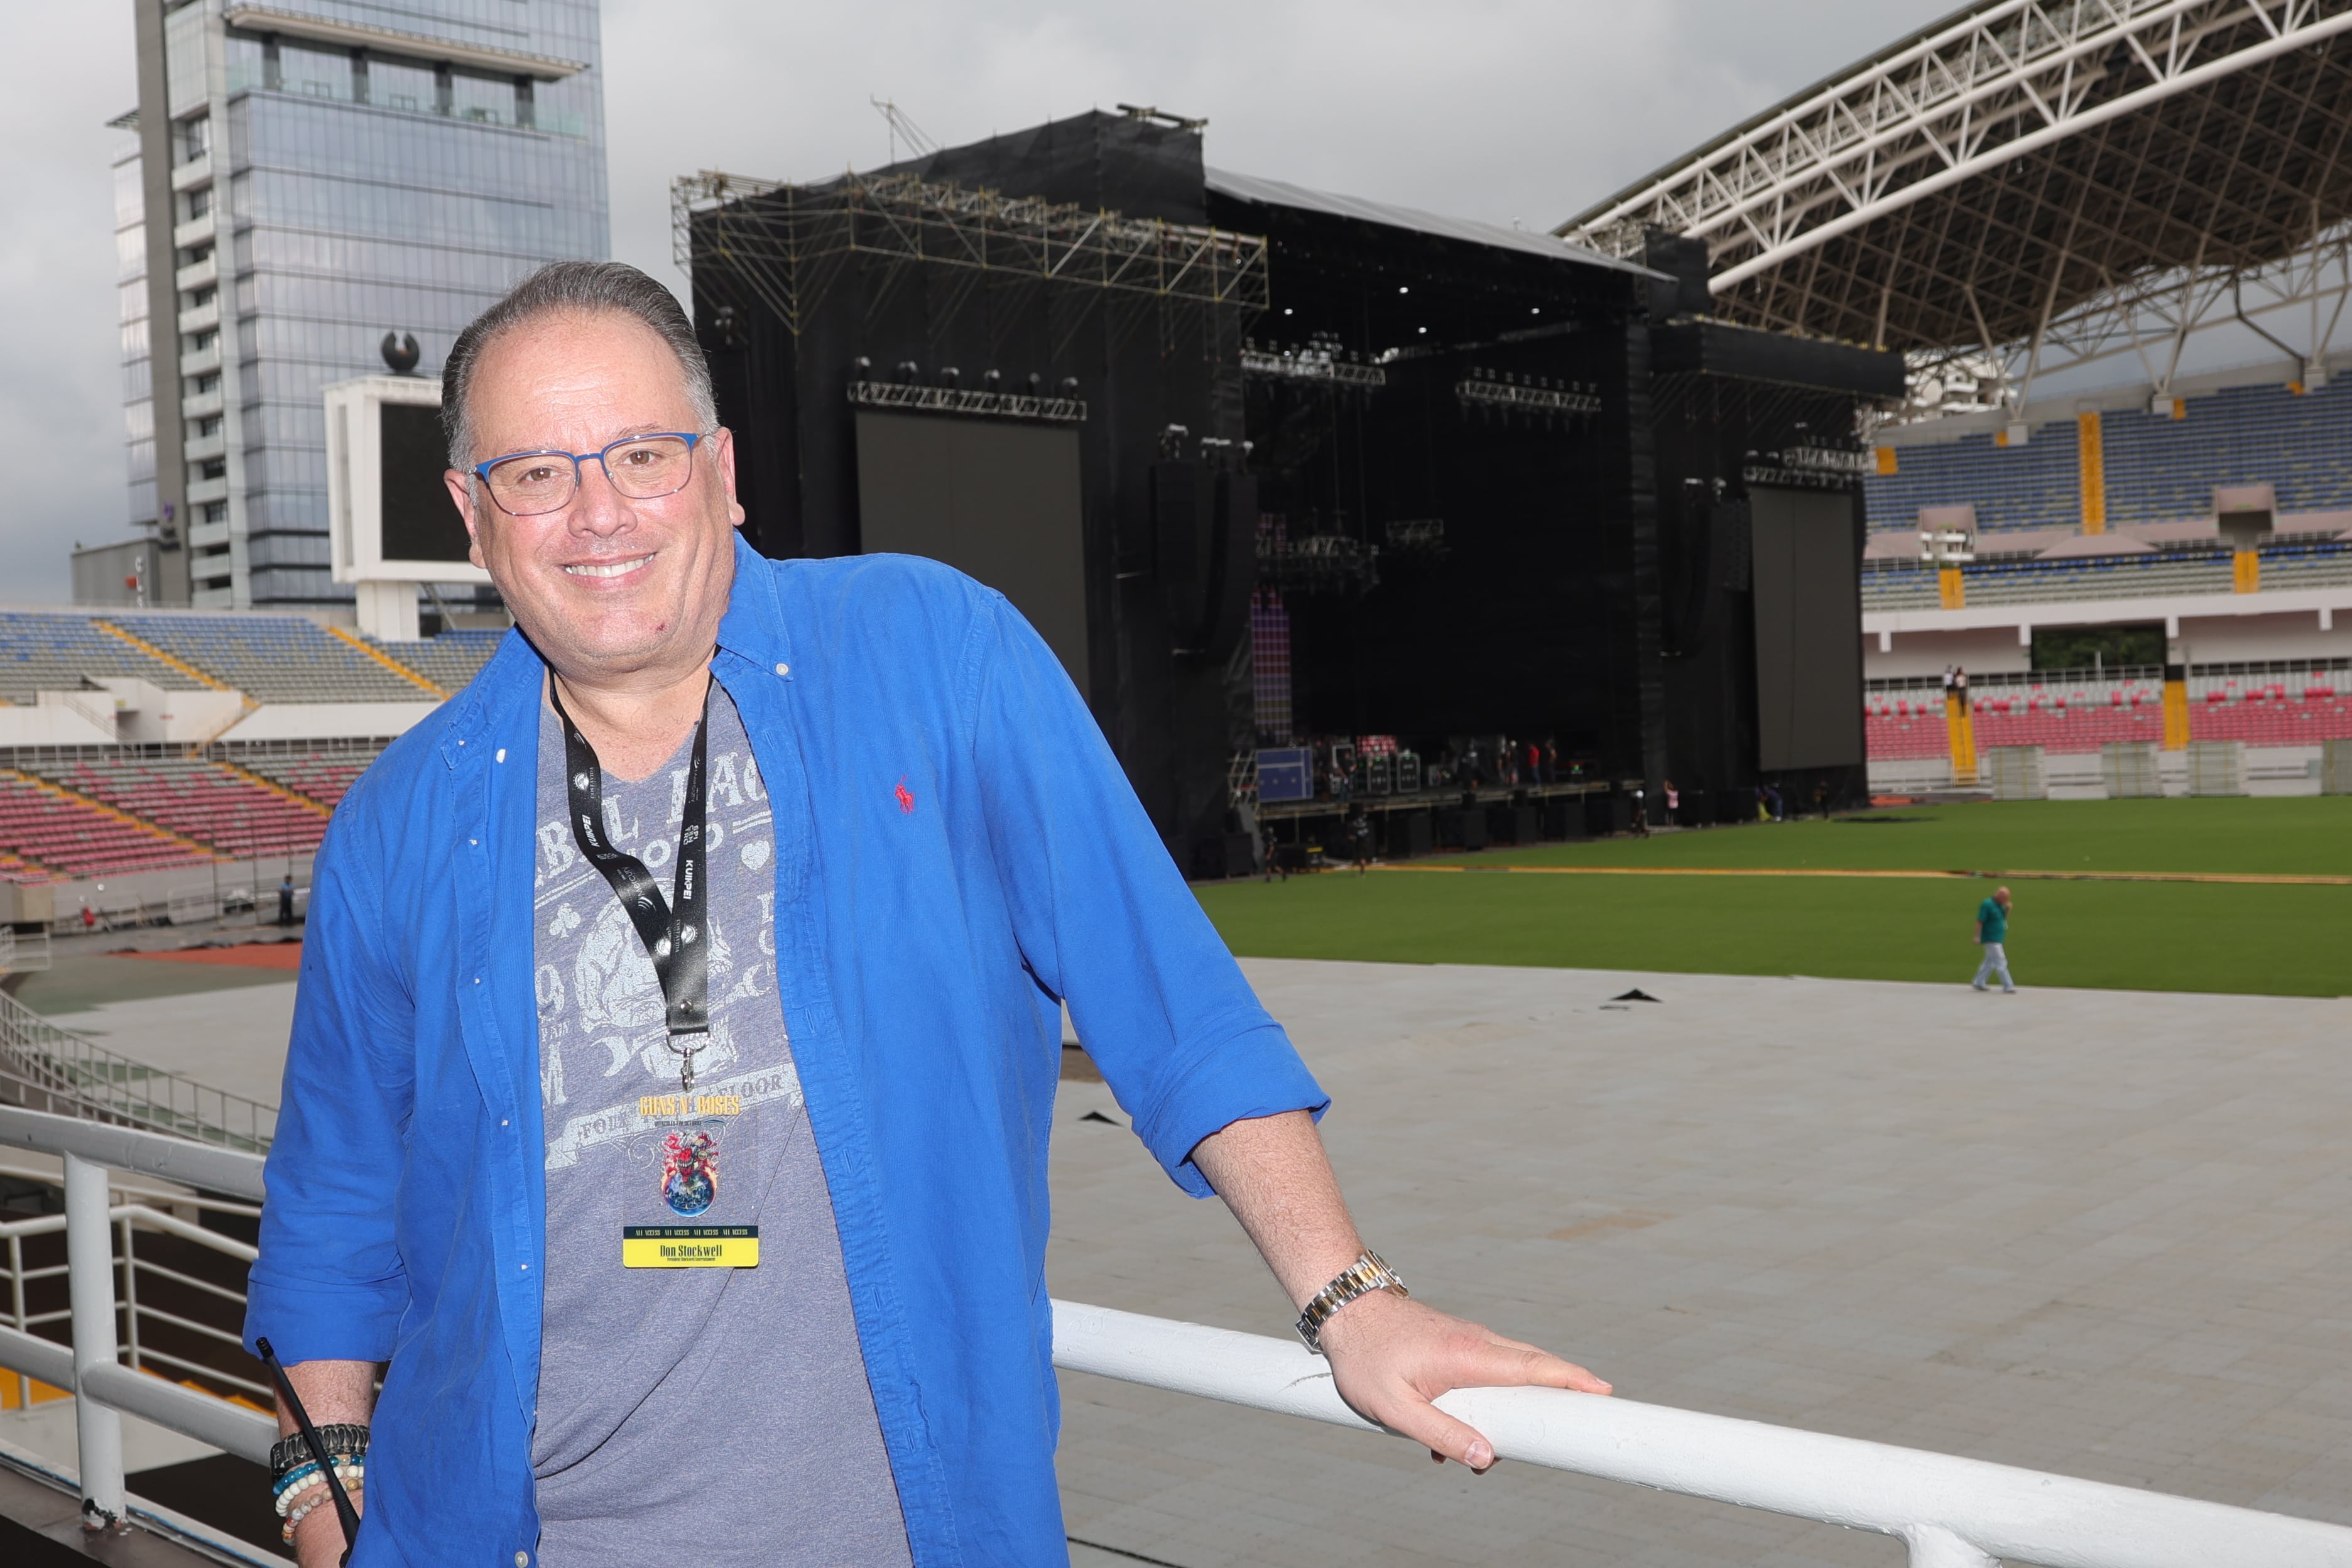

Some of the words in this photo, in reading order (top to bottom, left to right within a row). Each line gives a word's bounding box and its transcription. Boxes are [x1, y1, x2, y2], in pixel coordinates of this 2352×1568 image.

[683, 859, 694, 900] KUIKPEI
[640, 1096, 675, 1116] GUNS
[697, 1095, 741, 1116] ROSES
[660, 1245, 676, 1257] Don
[678, 1244, 722, 1257] Stockwell
